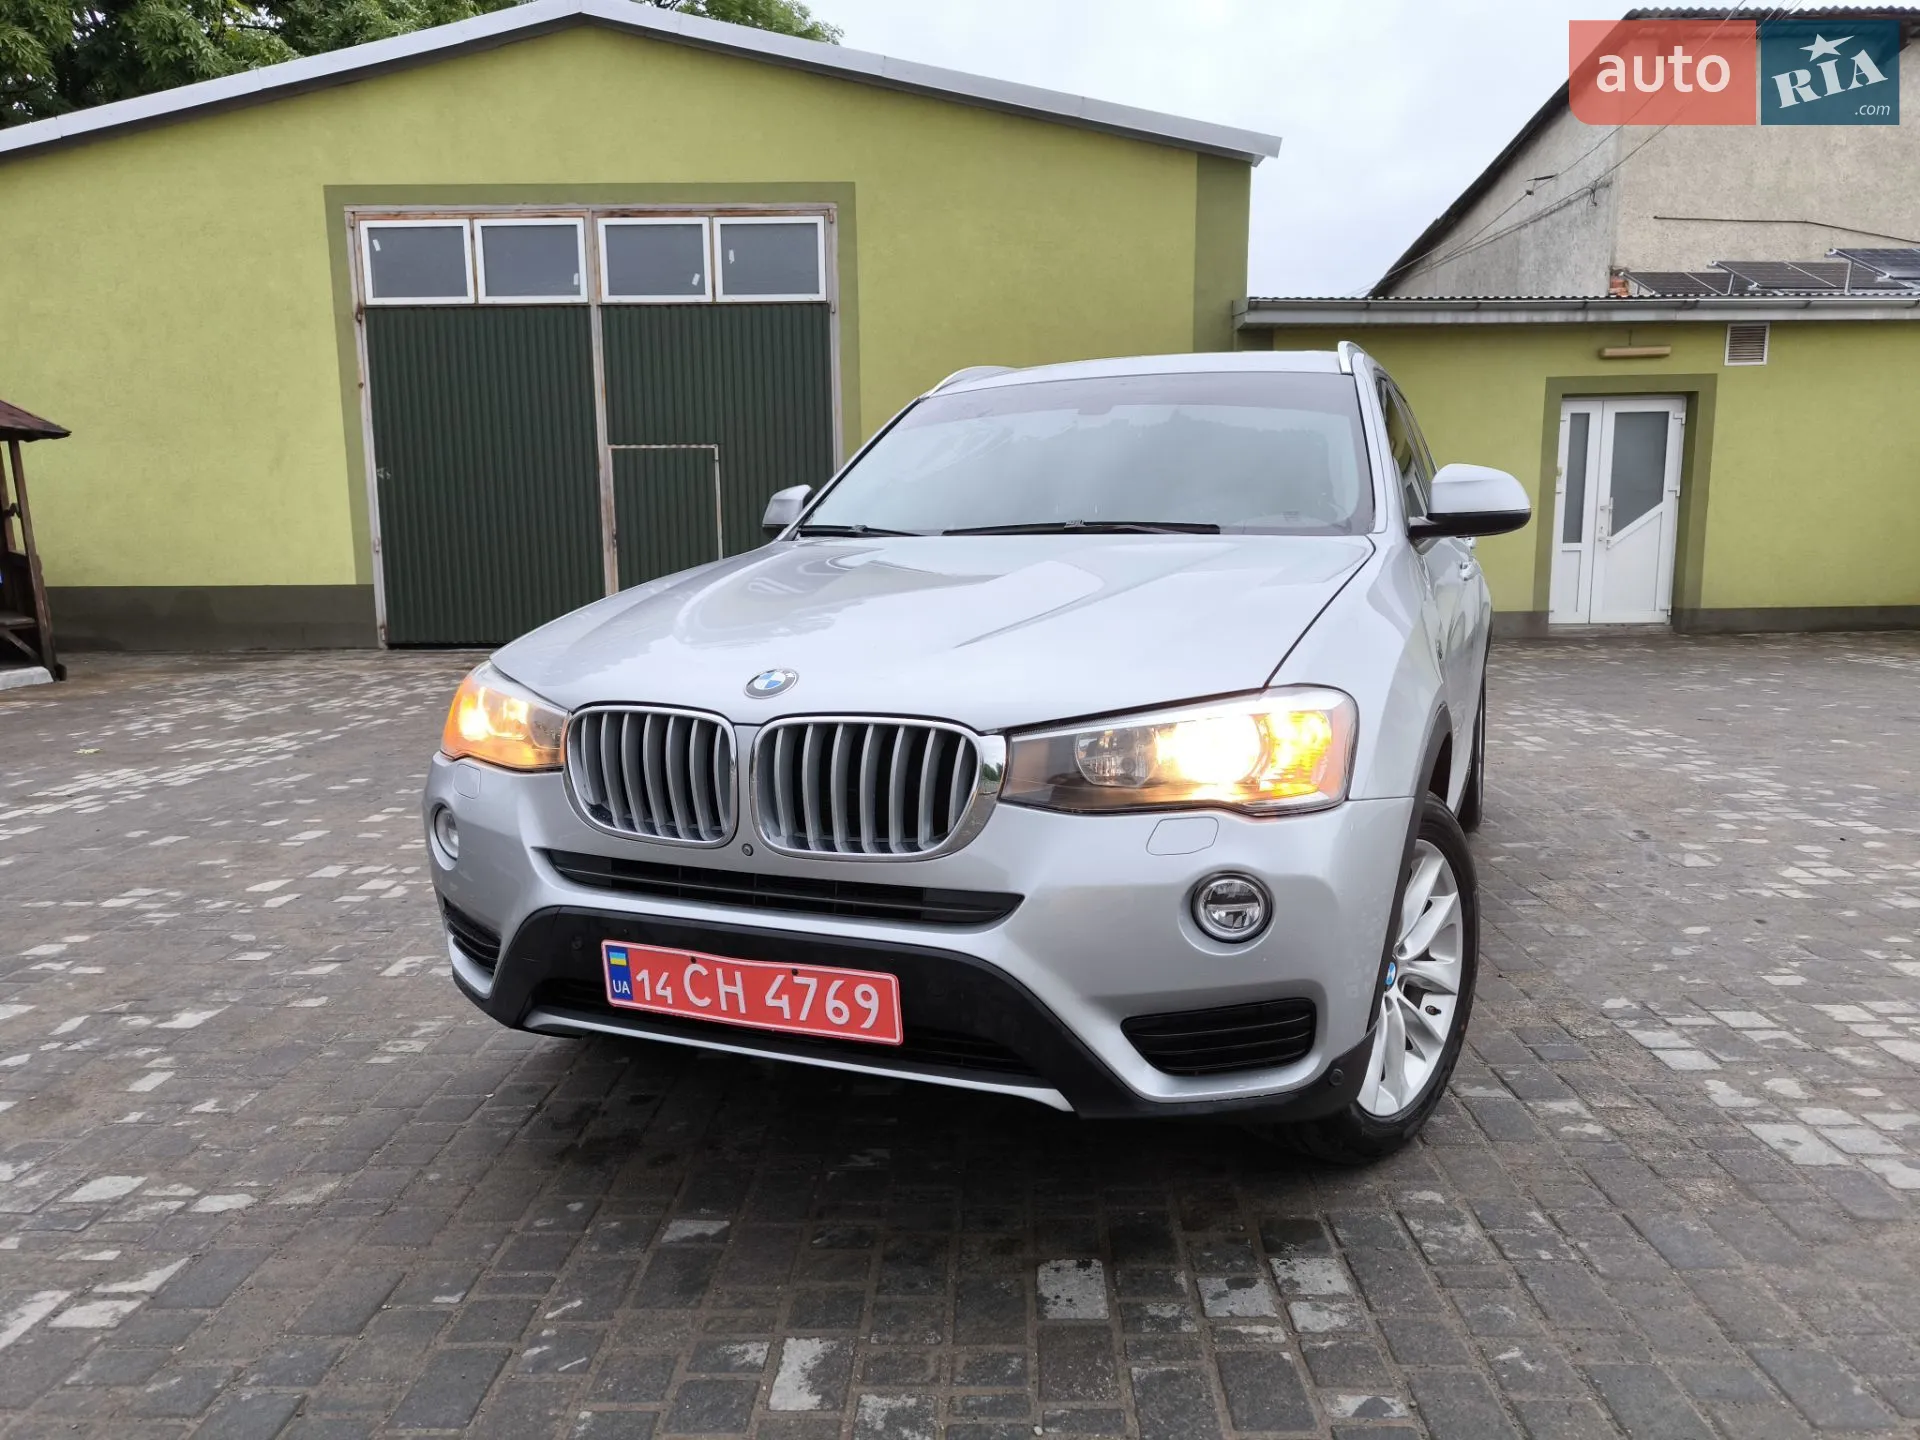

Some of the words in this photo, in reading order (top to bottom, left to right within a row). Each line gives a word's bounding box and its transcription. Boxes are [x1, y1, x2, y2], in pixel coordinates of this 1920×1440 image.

[612, 979, 631, 995] UA
[635, 968, 673, 1005] 14
[764, 974, 880, 1030] 4769
